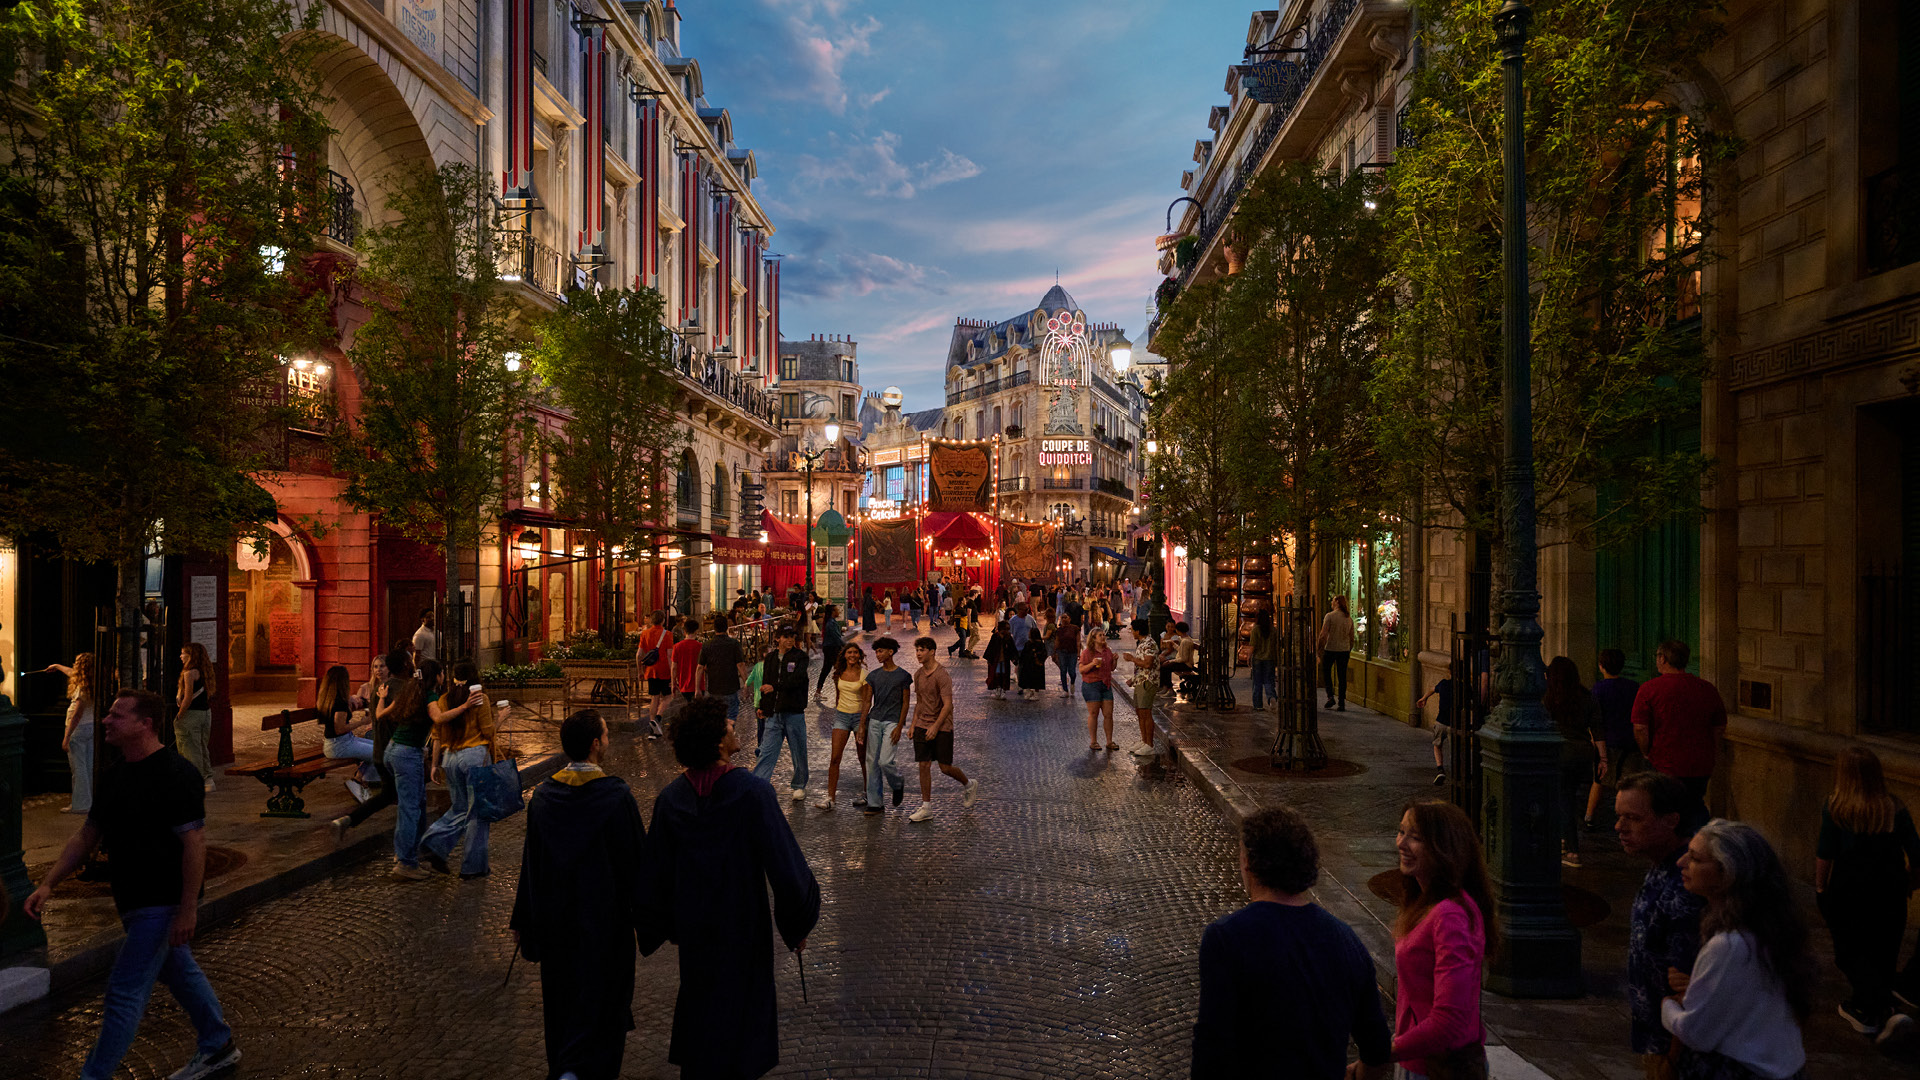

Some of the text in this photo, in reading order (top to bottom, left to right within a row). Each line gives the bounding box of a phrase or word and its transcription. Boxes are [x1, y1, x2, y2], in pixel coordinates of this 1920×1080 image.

[1251, 66, 1295, 79] MADAME
[1053, 378, 1078, 386] PARIS
[1042, 440, 1090, 452] COUPE DE
[1039, 452, 1092, 466] QUIDDITCH
